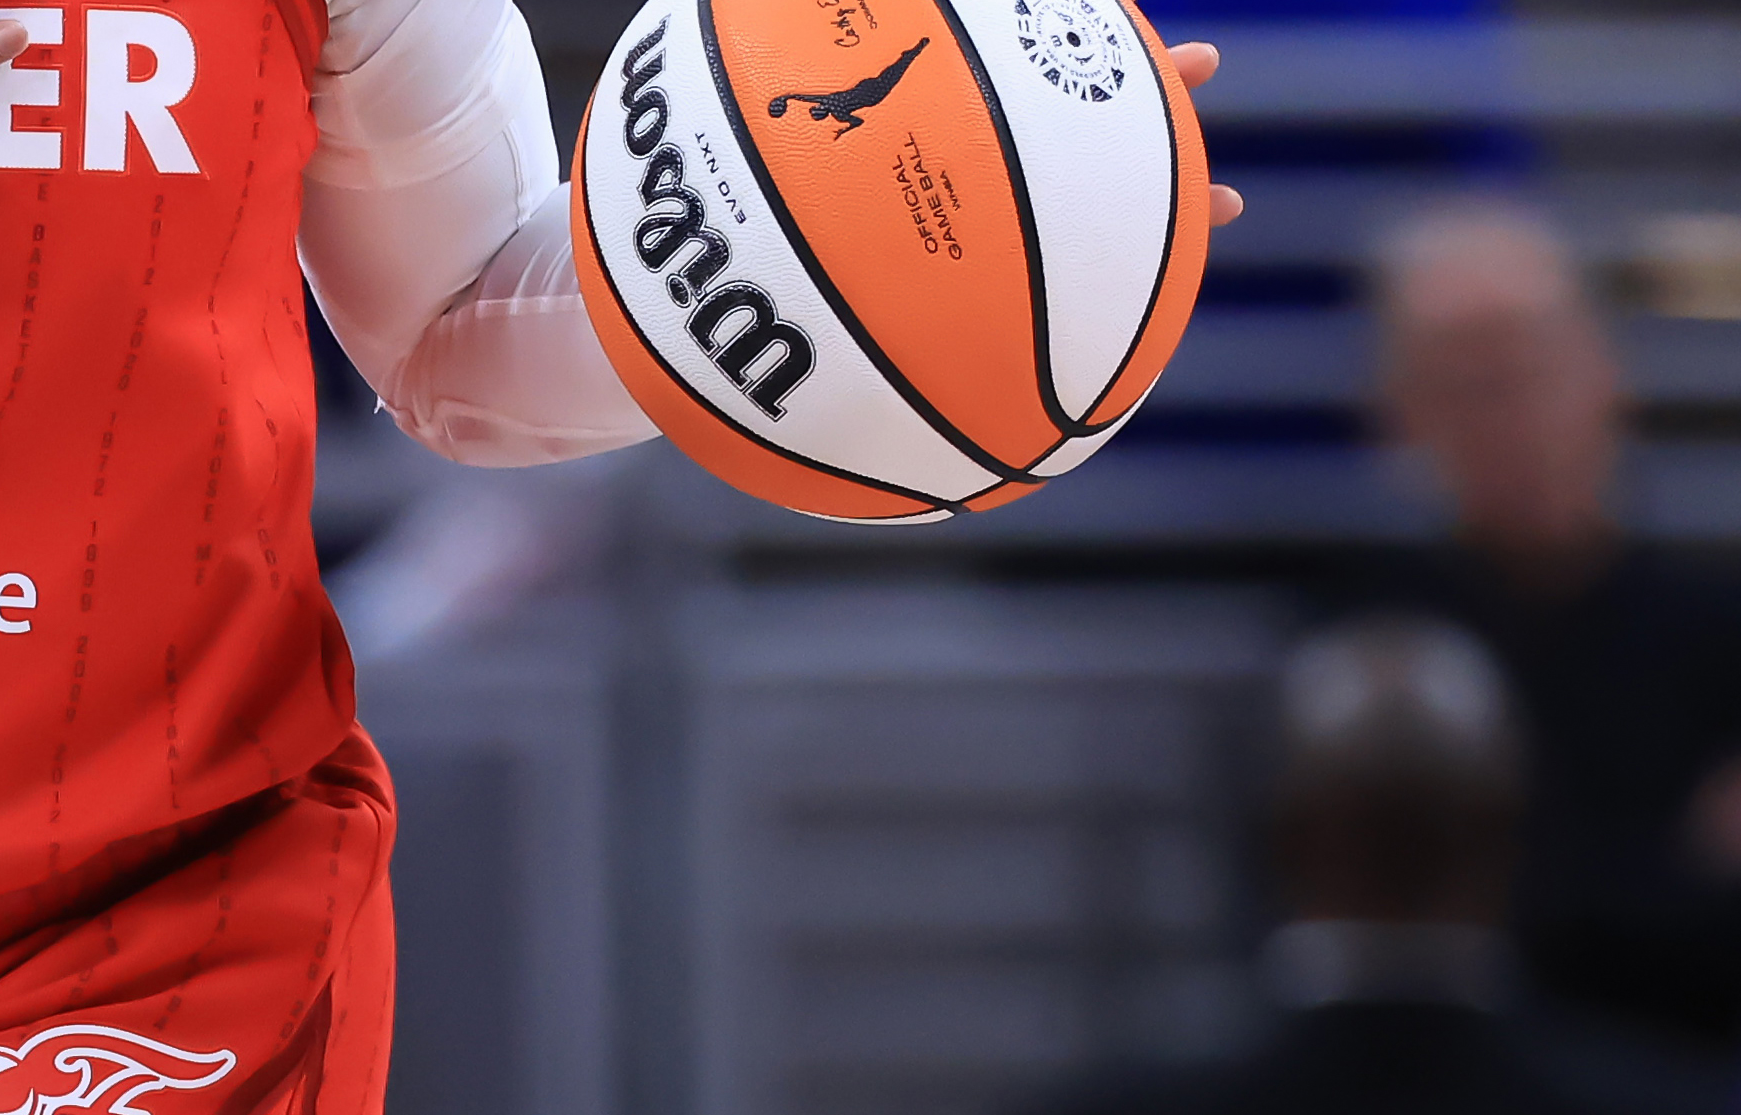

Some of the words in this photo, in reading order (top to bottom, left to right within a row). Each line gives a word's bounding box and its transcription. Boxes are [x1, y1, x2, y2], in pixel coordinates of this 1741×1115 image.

[693, 131, 720, 175] NXT
[903, 131, 936, 191] BALL
[620, 12, 818, 424] Wilson
[717, 180, 748, 226] EVO
[892, 154, 940, 255] OFFICIAL
[926, 193, 964, 261] GAME
